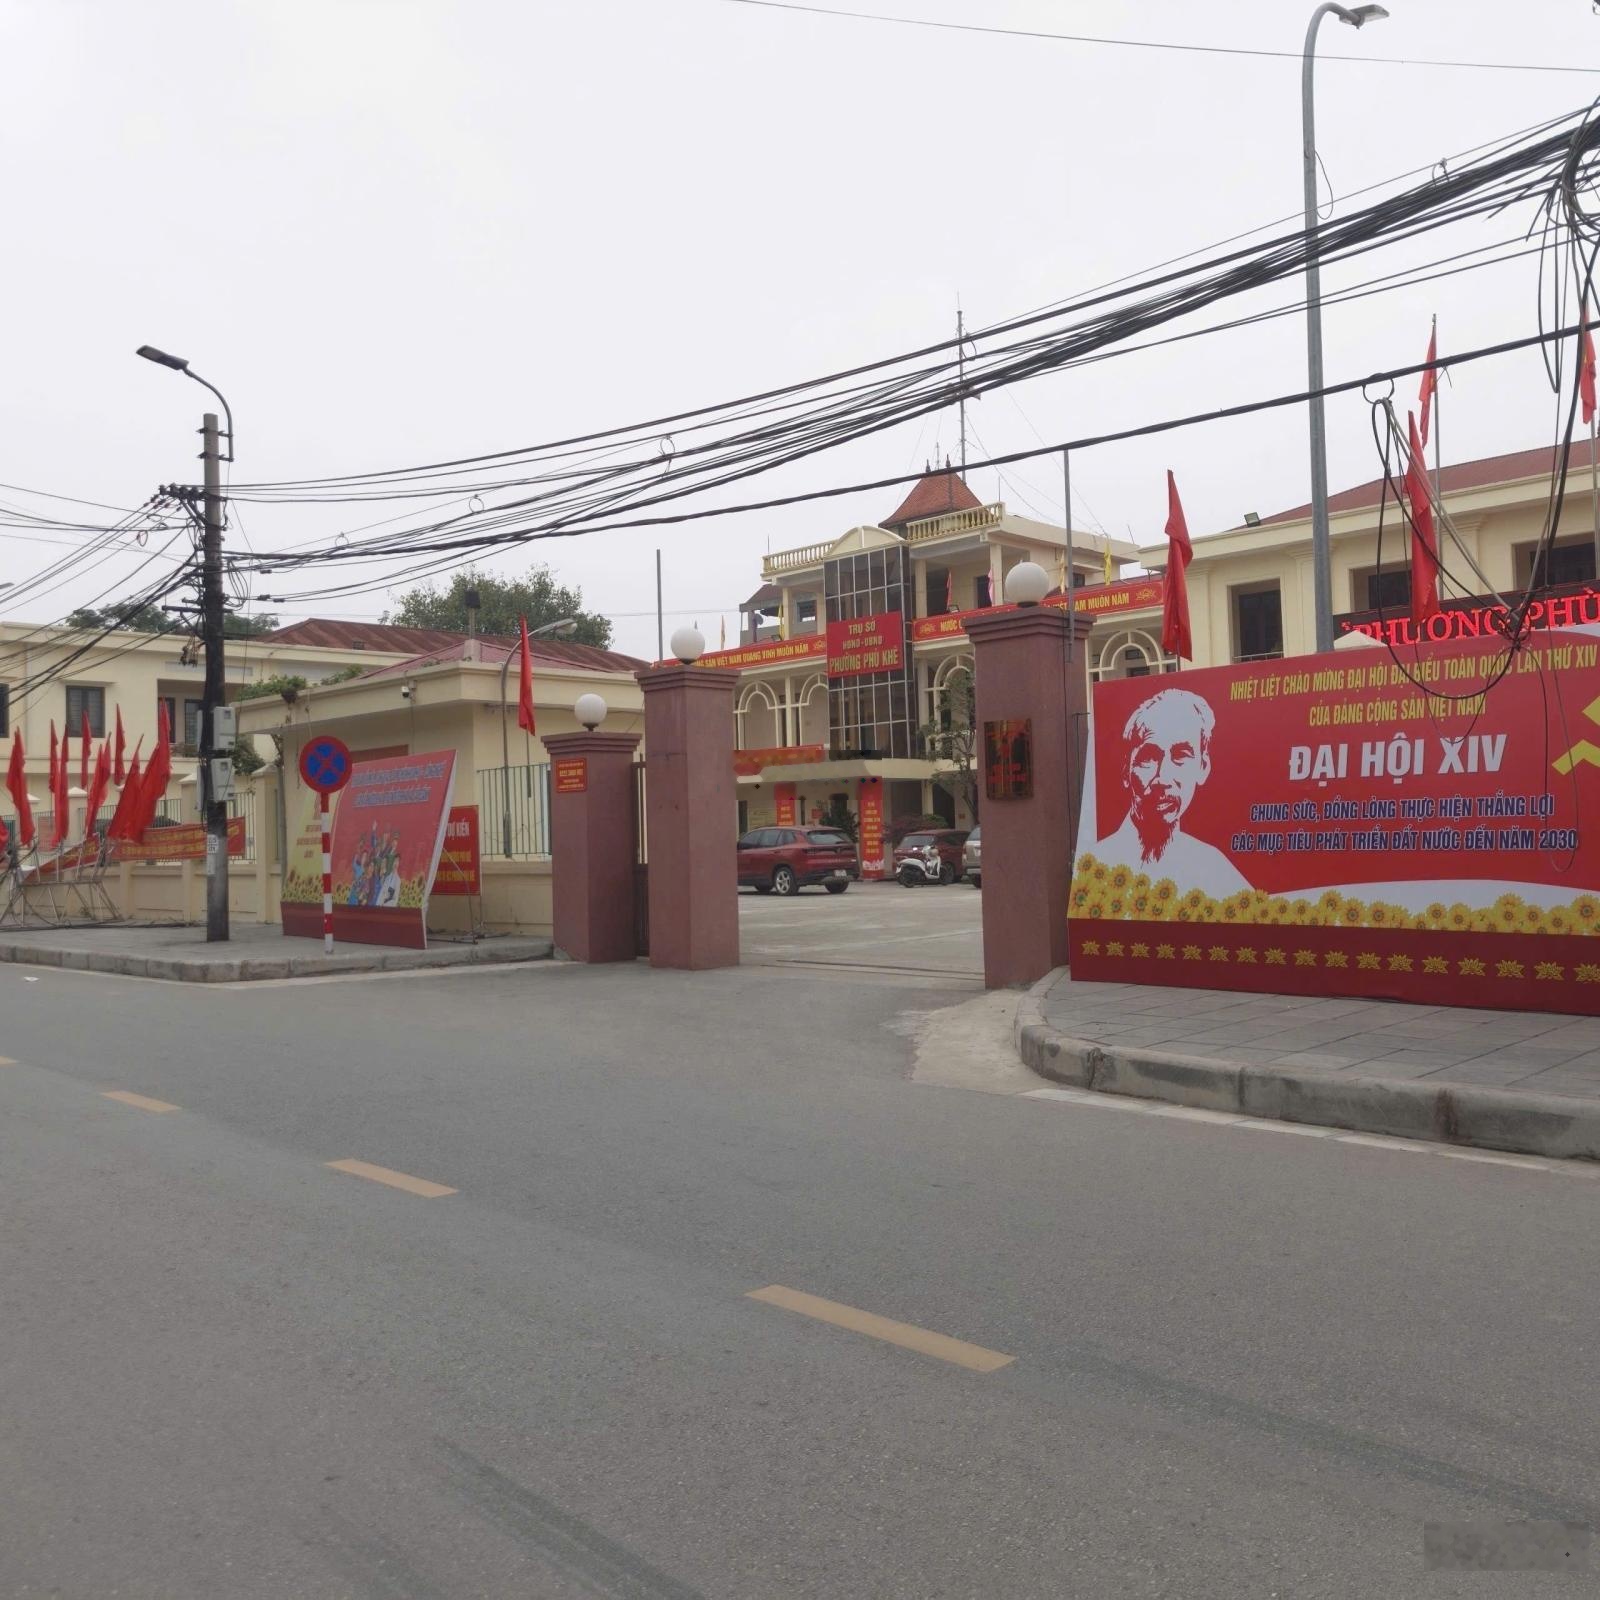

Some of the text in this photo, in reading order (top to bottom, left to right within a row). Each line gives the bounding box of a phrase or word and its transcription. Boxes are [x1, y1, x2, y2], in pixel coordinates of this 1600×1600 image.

[848, 618, 876, 636] TRỤ SỞ
[762, 648, 776, 659] VINH
[776, 645, 794, 657] MUÔN
[795, 641, 809, 654] NĂM
[829, 652, 861, 673] PHƯỜNG
[882, 645, 899, 666] KHÊ
[1230, 642, 1598, 702] NHIỆT LIỆT CHÀO MỪNG ĐẠI HỘI ĐẠI BIỂU TOÀN QUỐC LẦN THỨ XIV
[1309, 691, 1486, 727] CỦA ĐẢNG CỘNG SẢN VIỆT NAM
[1289, 731, 1508, 788] ĐẠI HỘI XIV
[1250, 789, 1555, 823] CHUNG SỨC, ĐỒNG LÒNG THỰC HIỆN THẮNG LỢI
[1231, 824, 1578, 855] CÁC MỤC TIÊU PHÁT TRIỂN ĐẤT NƯỚC ĐẾN NĂM 2030
